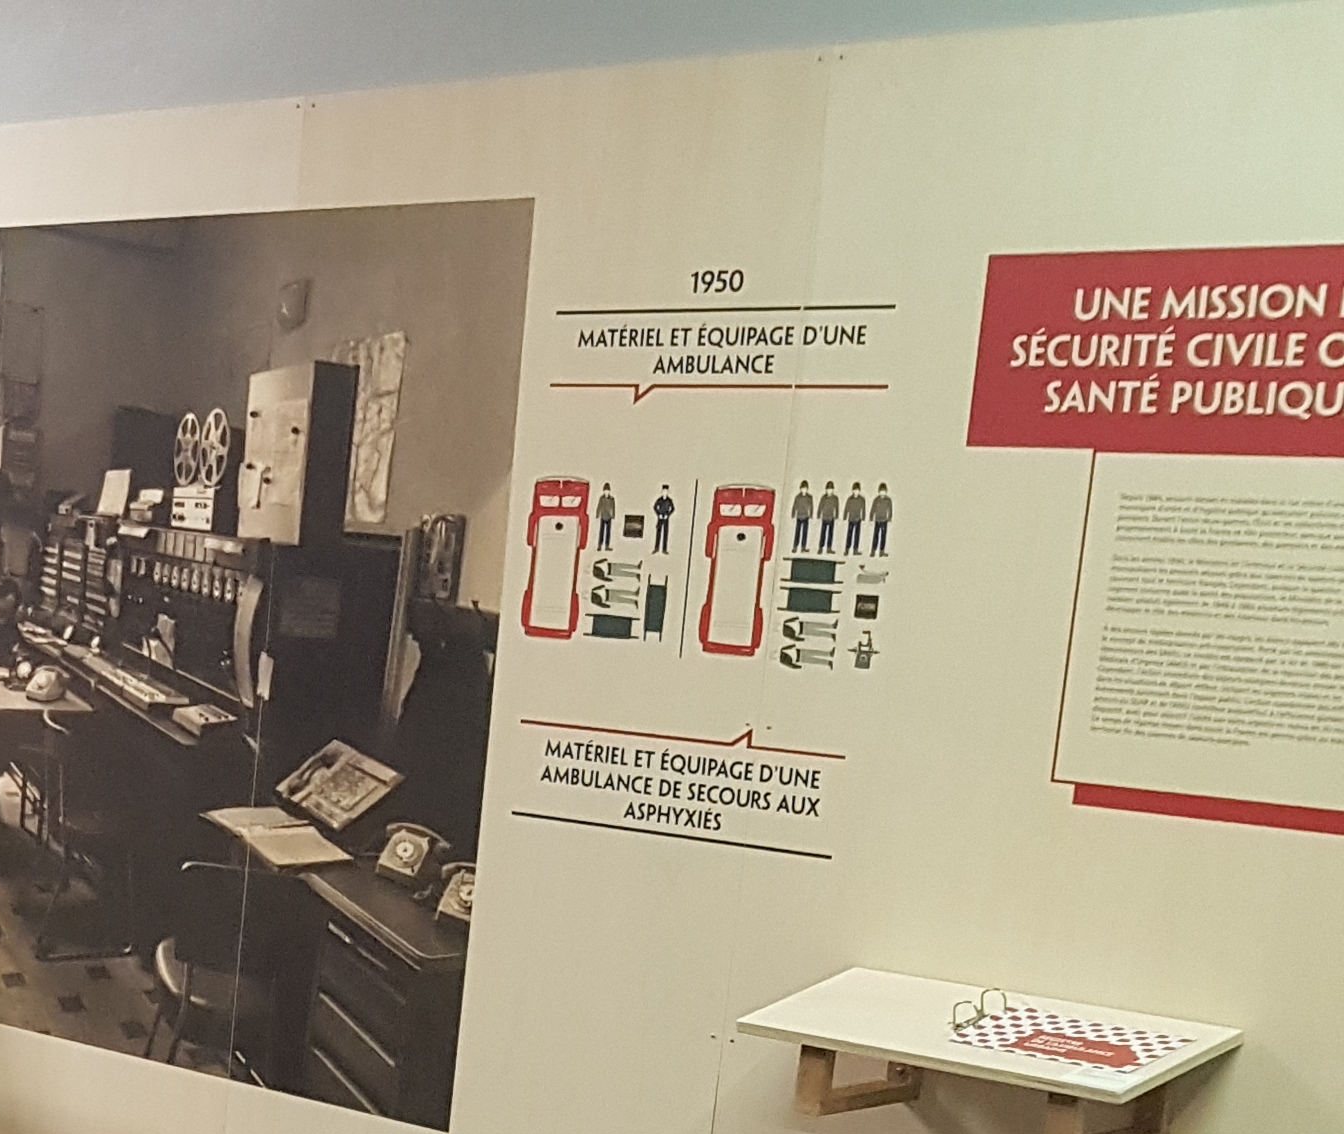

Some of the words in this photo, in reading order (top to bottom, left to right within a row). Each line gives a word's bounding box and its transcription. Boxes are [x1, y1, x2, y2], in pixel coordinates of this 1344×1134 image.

[690, 269, 745, 294] 1950
[1074, 286, 1153, 321] UNE
[1160, 283, 1328, 320] MISSION
[577, 323, 665, 348] MATÉRIEL
[670, 328, 693, 347] ET
[697, 323, 795, 348] ÉQUIPAGE
[802, 325, 867, 346] D'UNE
[1010, 326, 1176, 367] SÉCURITÉ
[1186, 332, 1308, 368] CIVILE
[1318, 332, 1344, 368] O
[652, 354, 775, 375] AMBULANCE
[1044, 373, 1160, 414] SANTÉ
[1170, 381, 1344, 420] PUBLIQU
[544, 739, 629, 767] MATÉRIEL
[634, 750, 656, 769] ET
[659, 748, 754, 782] ÉQUIPAGE
[759, 764, 822, 790] D'UNE
[540, 765, 653, 796] AMBULANCE
[658, 779, 682, 799] DE
[686, 783, 771, 811] SECOURS
[776, 794, 821, 818] AUX
[623, 802, 722, 831] ASPHYXIÉS
